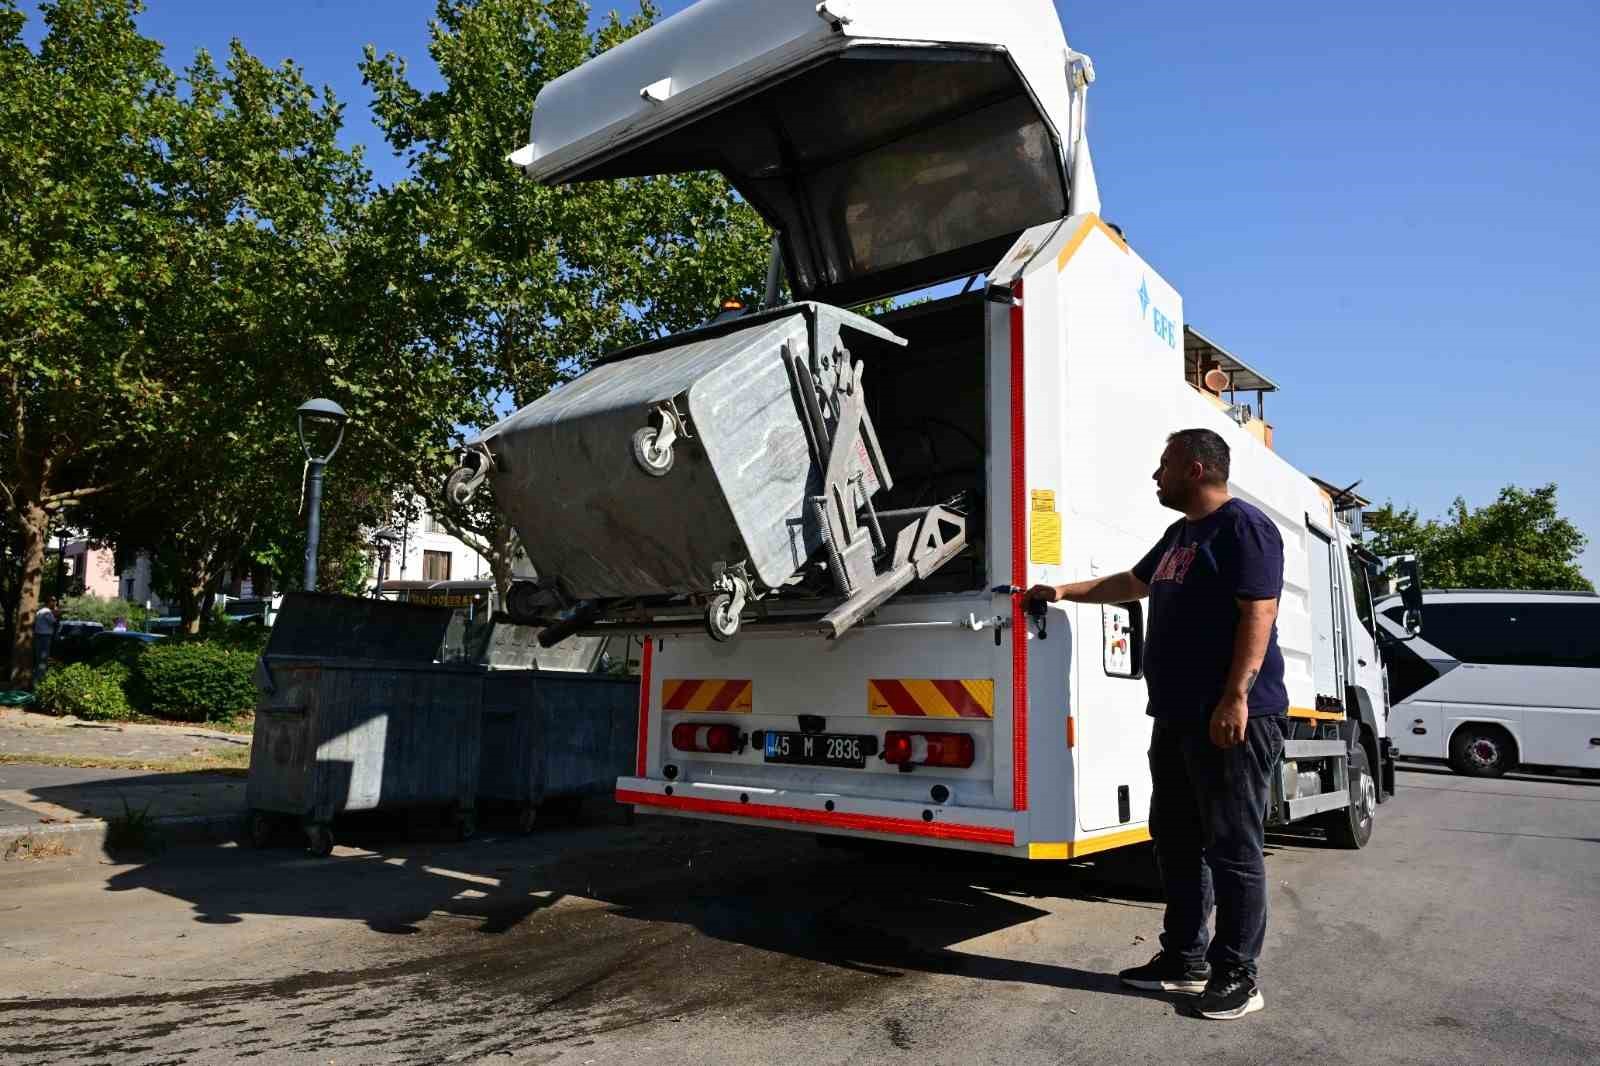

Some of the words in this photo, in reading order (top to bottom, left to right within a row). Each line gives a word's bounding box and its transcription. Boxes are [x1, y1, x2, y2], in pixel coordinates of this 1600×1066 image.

[1153, 306, 1176, 350] EFE
[774, 736, 790, 756] 45
[803, 737, 814, 758] M
[826, 738, 861, 760] 2836
